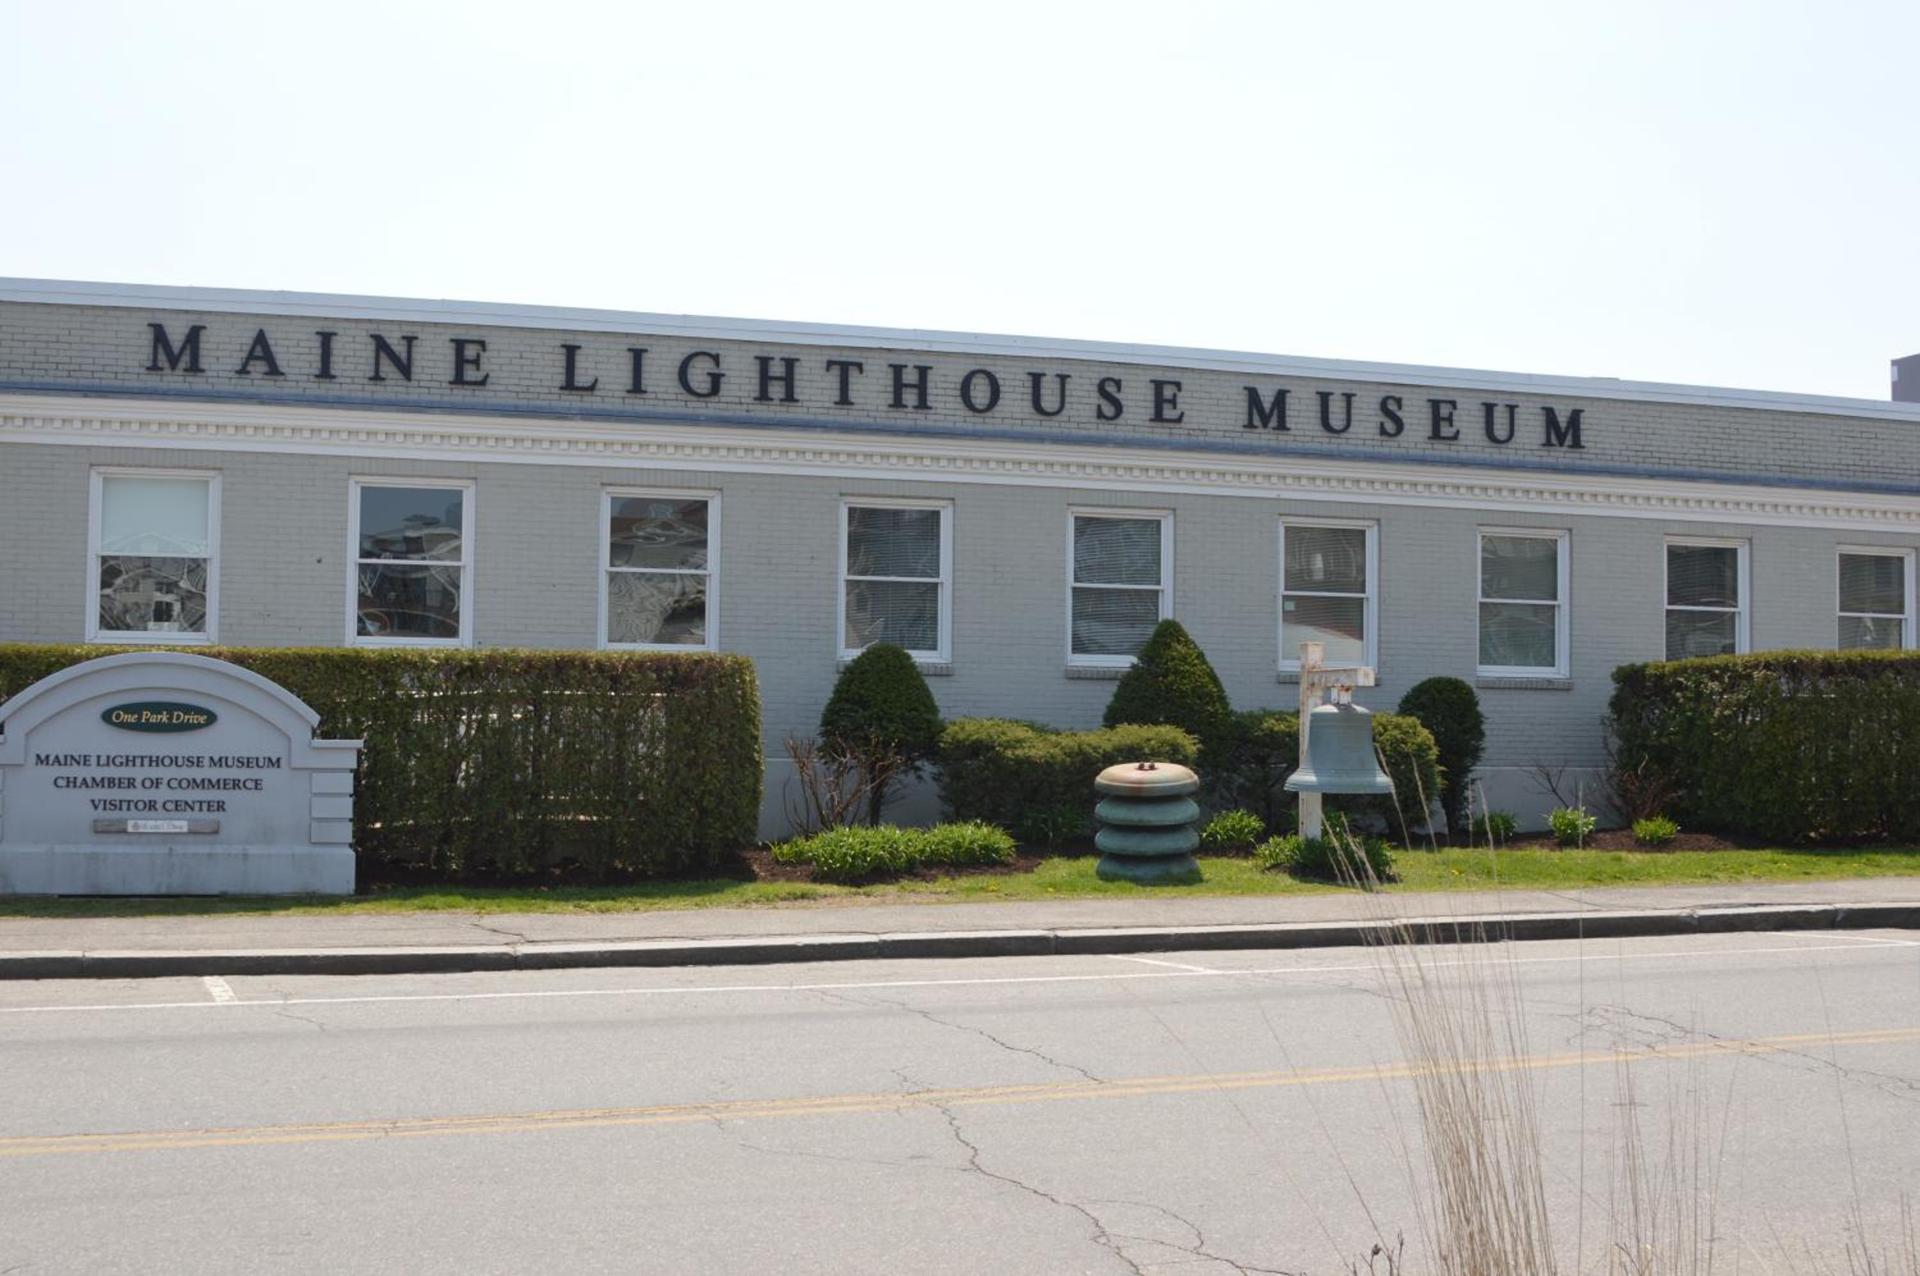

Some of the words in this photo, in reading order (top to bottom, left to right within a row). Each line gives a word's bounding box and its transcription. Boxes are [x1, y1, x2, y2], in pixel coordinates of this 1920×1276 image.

[146, 323, 490, 386] MAINE
[559, 344, 1185, 424] LIGHTHOUSE
[1243, 386, 1585, 449] MUSEUM
[112, 710, 138, 724] One
[141, 710, 169, 724] Park
[172, 711, 208, 724] Drive
[35, 753, 92, 768] MAINE
[96, 754, 206, 769] LIGHTHOUSE
[208, 755, 282, 769] MUSEUM
[53, 776, 137, 791] CHAMBER
[142, 777, 164, 791] OF
[167, 777, 264, 791] COMMERCE
[90, 798, 158, 812] VISITOR
[162, 798, 226, 813] CENTER
